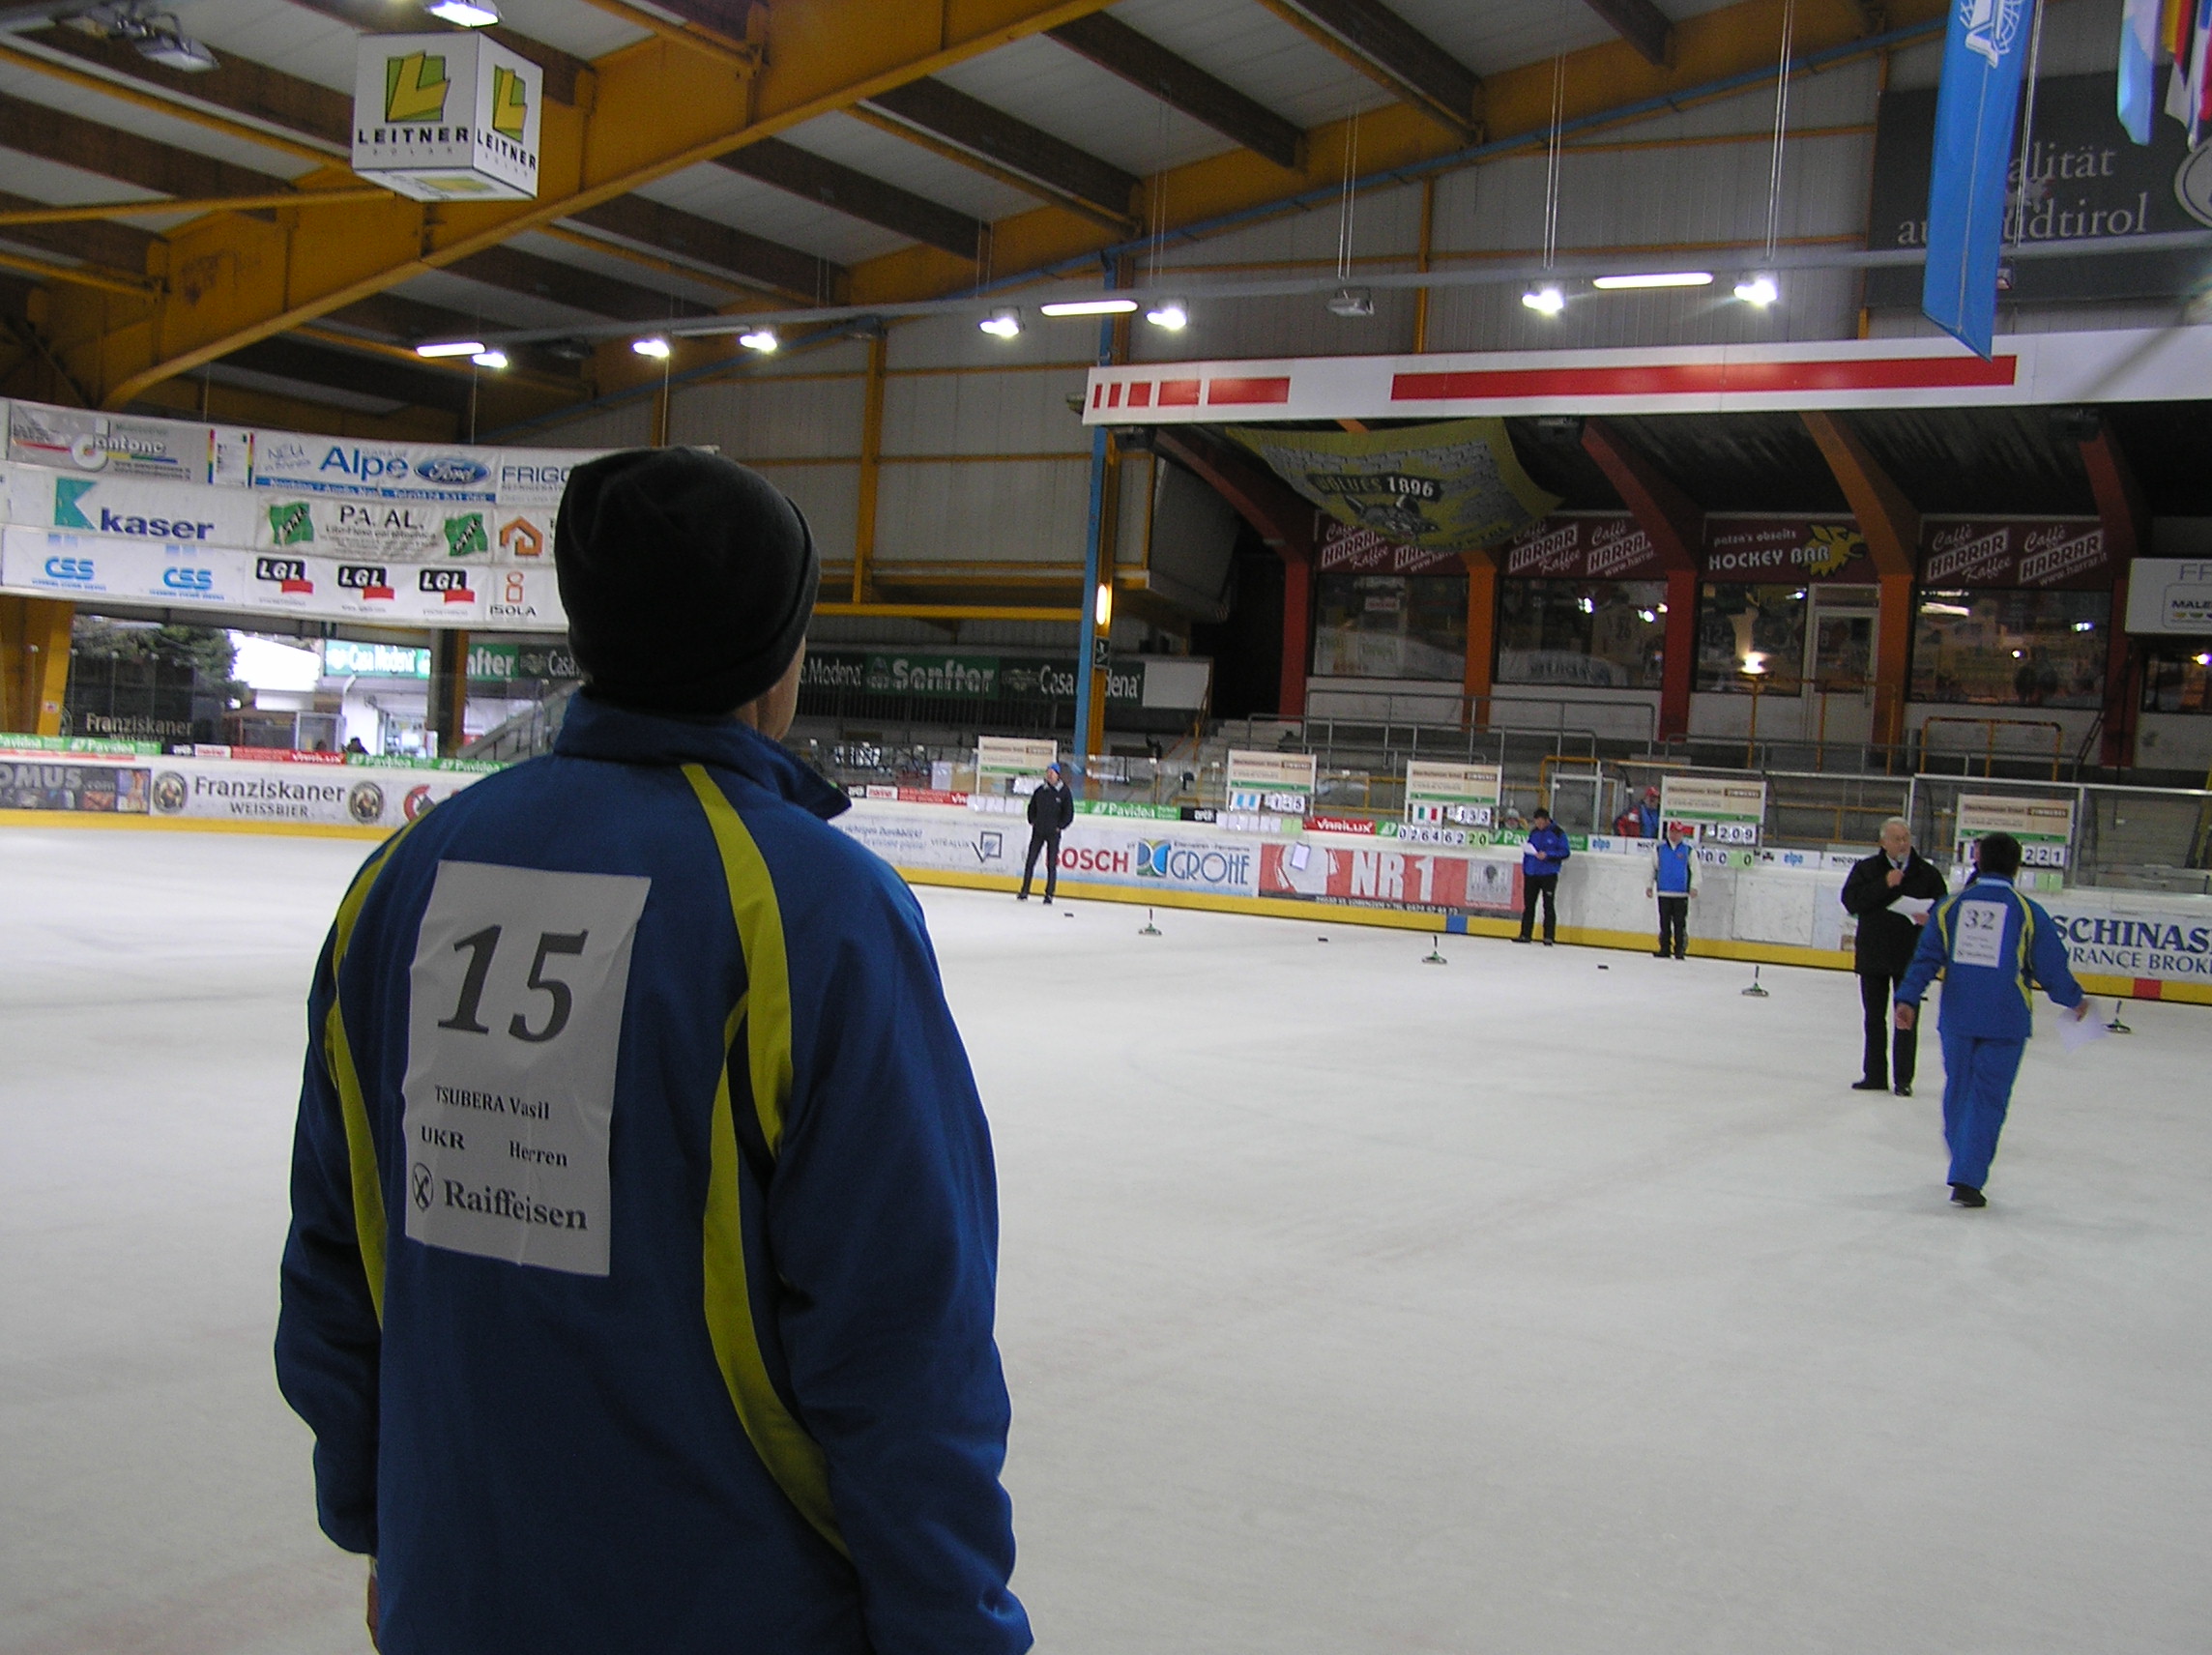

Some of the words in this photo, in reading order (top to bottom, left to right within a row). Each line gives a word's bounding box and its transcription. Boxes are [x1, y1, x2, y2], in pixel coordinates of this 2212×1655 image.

[358, 127, 470, 144] LEITNER
[477, 129, 538, 171] LEITNER
[2007, 141, 2117, 184] alität
[2003, 191, 2148, 241] üdtirol
[318, 446, 409, 481] Alpe
[428, 460, 476, 482] Ford
[1387, 476, 1435, 498] 1896
[101, 508, 214, 539] kaser
[1511, 526, 1577, 572] HARRAR
[1538, 548, 1582, 575] Kaffee
[1708, 548, 1784, 571] HOCKEY
[1790, 545, 1830, 565] BAR
[1929, 533, 2006, 581] HARRAR
[2021, 534, 2101, 582] HARRAR
[44, 556, 95, 580] CSS
[162, 566, 214, 591] CSS
[258, 561, 306, 580] LGL
[340, 567, 385, 587] LGL
[422, 571, 466, 590] LGL
[1962, 556, 2013, 583] Kaffee
[489, 605, 537, 617] ISOLA
[349, 644, 374, 672] Casa
[467, 647, 514, 676] nfter
[1039, 663, 1074, 696] Casa
[1106, 667, 1142, 698] dena
[86, 711, 193, 738] Franziskaner
[195, 774, 345, 802] Franziskaner
[230, 801, 308, 818] WEISSBIER
[1108, 803, 1155, 819] Pavidea
[1720, 827, 1753, 839] 209
[1170, 850, 1250, 885] GROHE
[2025, 848, 2060, 862] 221
[1351, 849, 1405, 901] NR
[1415, 856, 1436, 903] 1
[1965, 909, 1994, 930] 32
[2052, 915, 2212, 953] SCHINAS
[2068, 945, 2141, 969] RANCE
[2148, 952, 2212, 974] BROK
[437, 923, 590, 1044] 15
[435, 1085, 506, 1114] TSUBERA
[509, 1096, 550, 1120] Vasil
[421, 1125, 465, 1150] UKR
[509, 1140, 568, 1168] Herren
[444, 1177, 588, 1231] Raiffeisen
